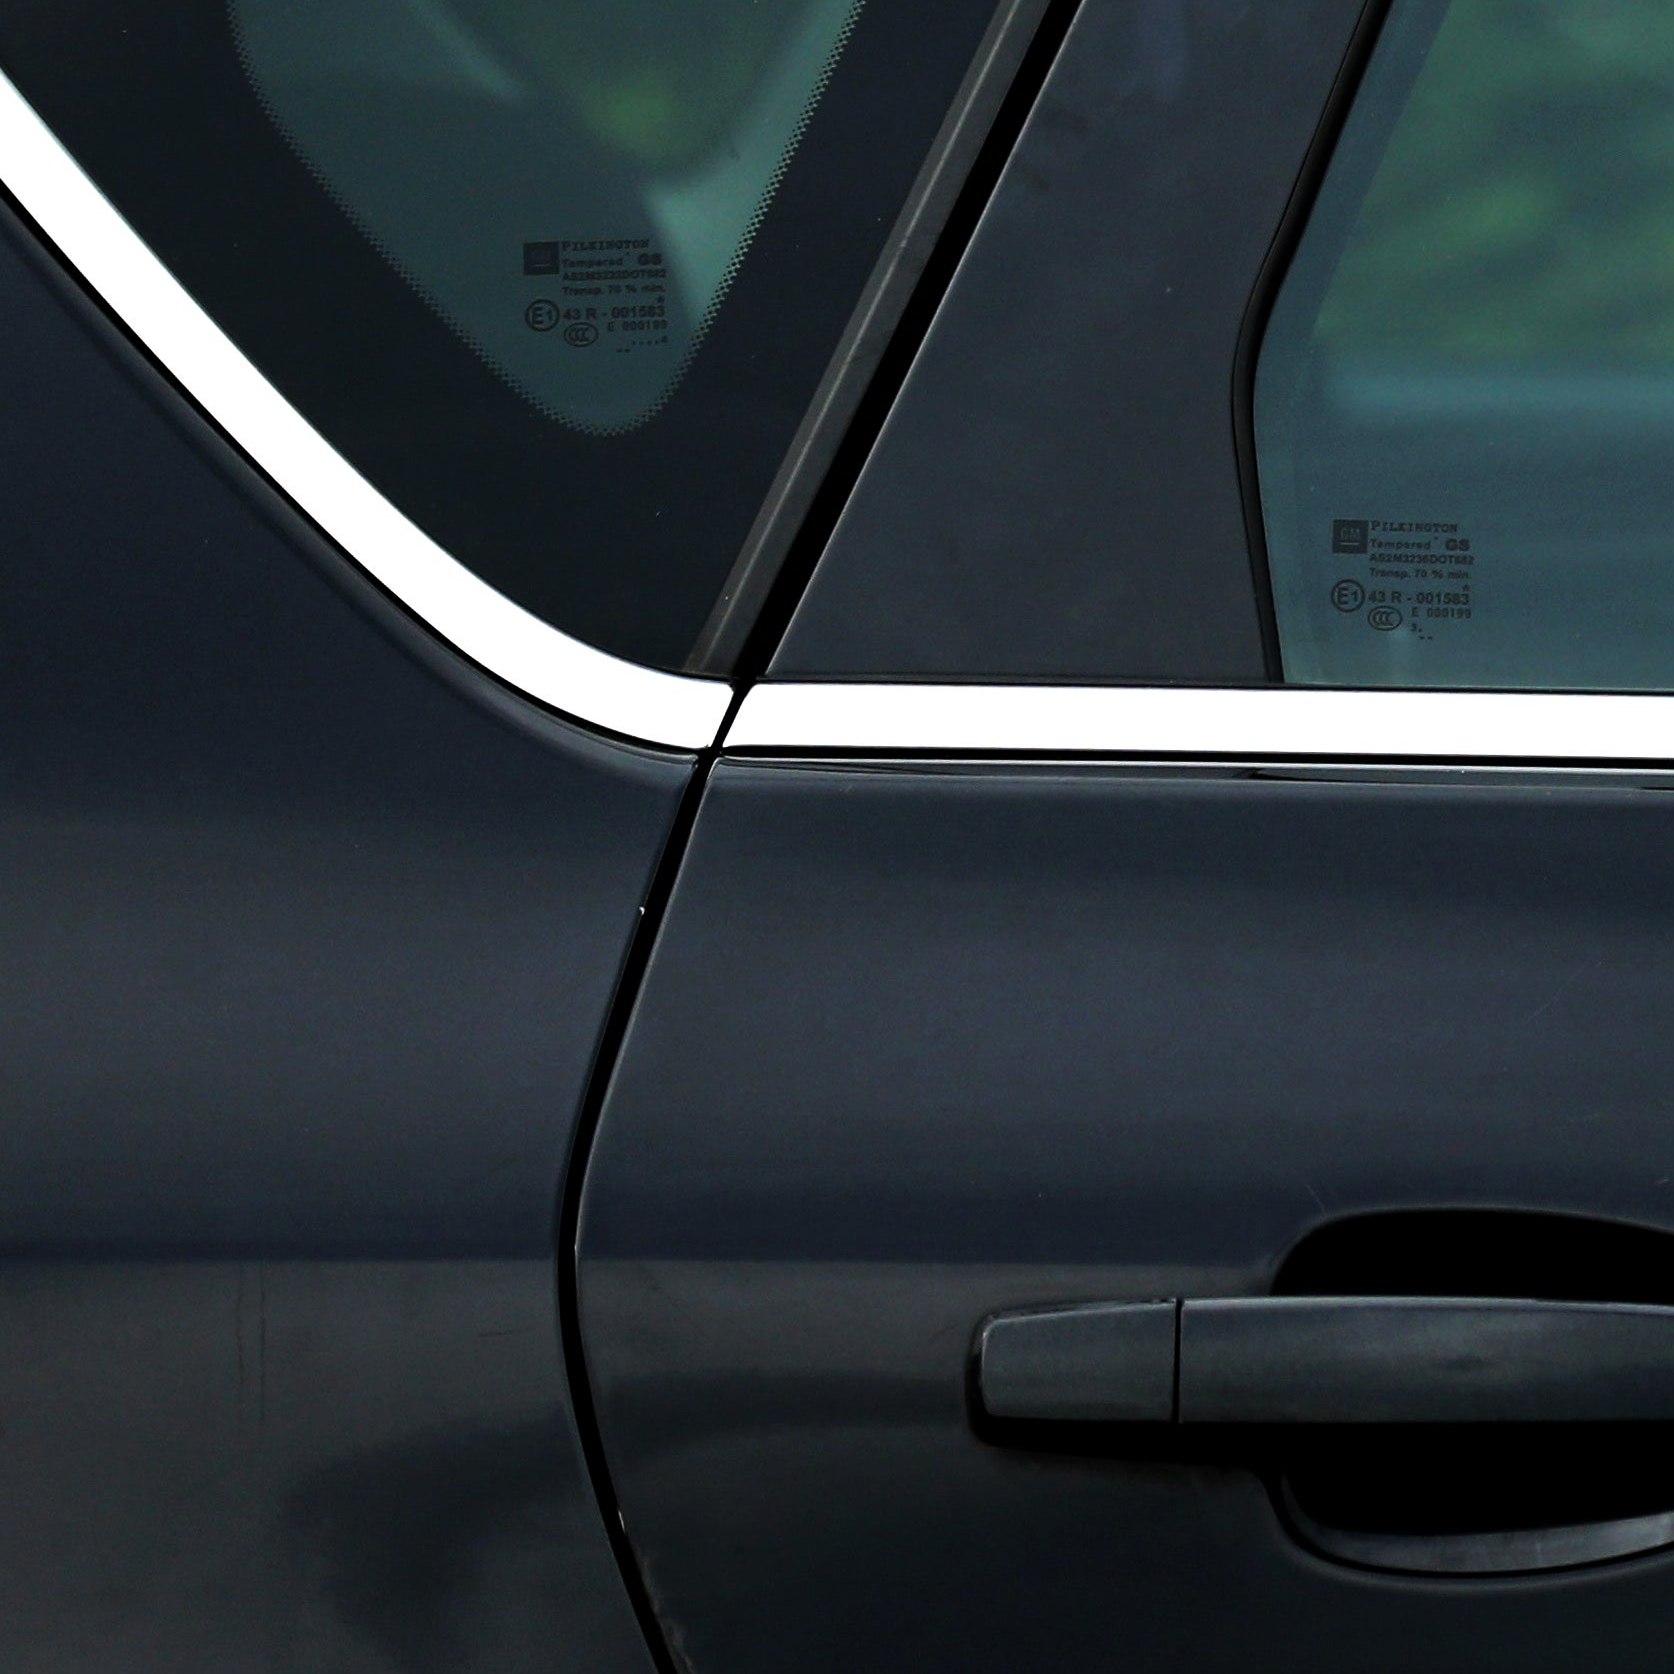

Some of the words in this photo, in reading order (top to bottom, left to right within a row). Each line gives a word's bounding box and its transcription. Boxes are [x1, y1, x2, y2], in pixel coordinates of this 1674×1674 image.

[1371, 521, 1458, 533] PILKINGTON
[1369, 591, 1385, 603] 43
[1391, 591, 1401, 603] R
